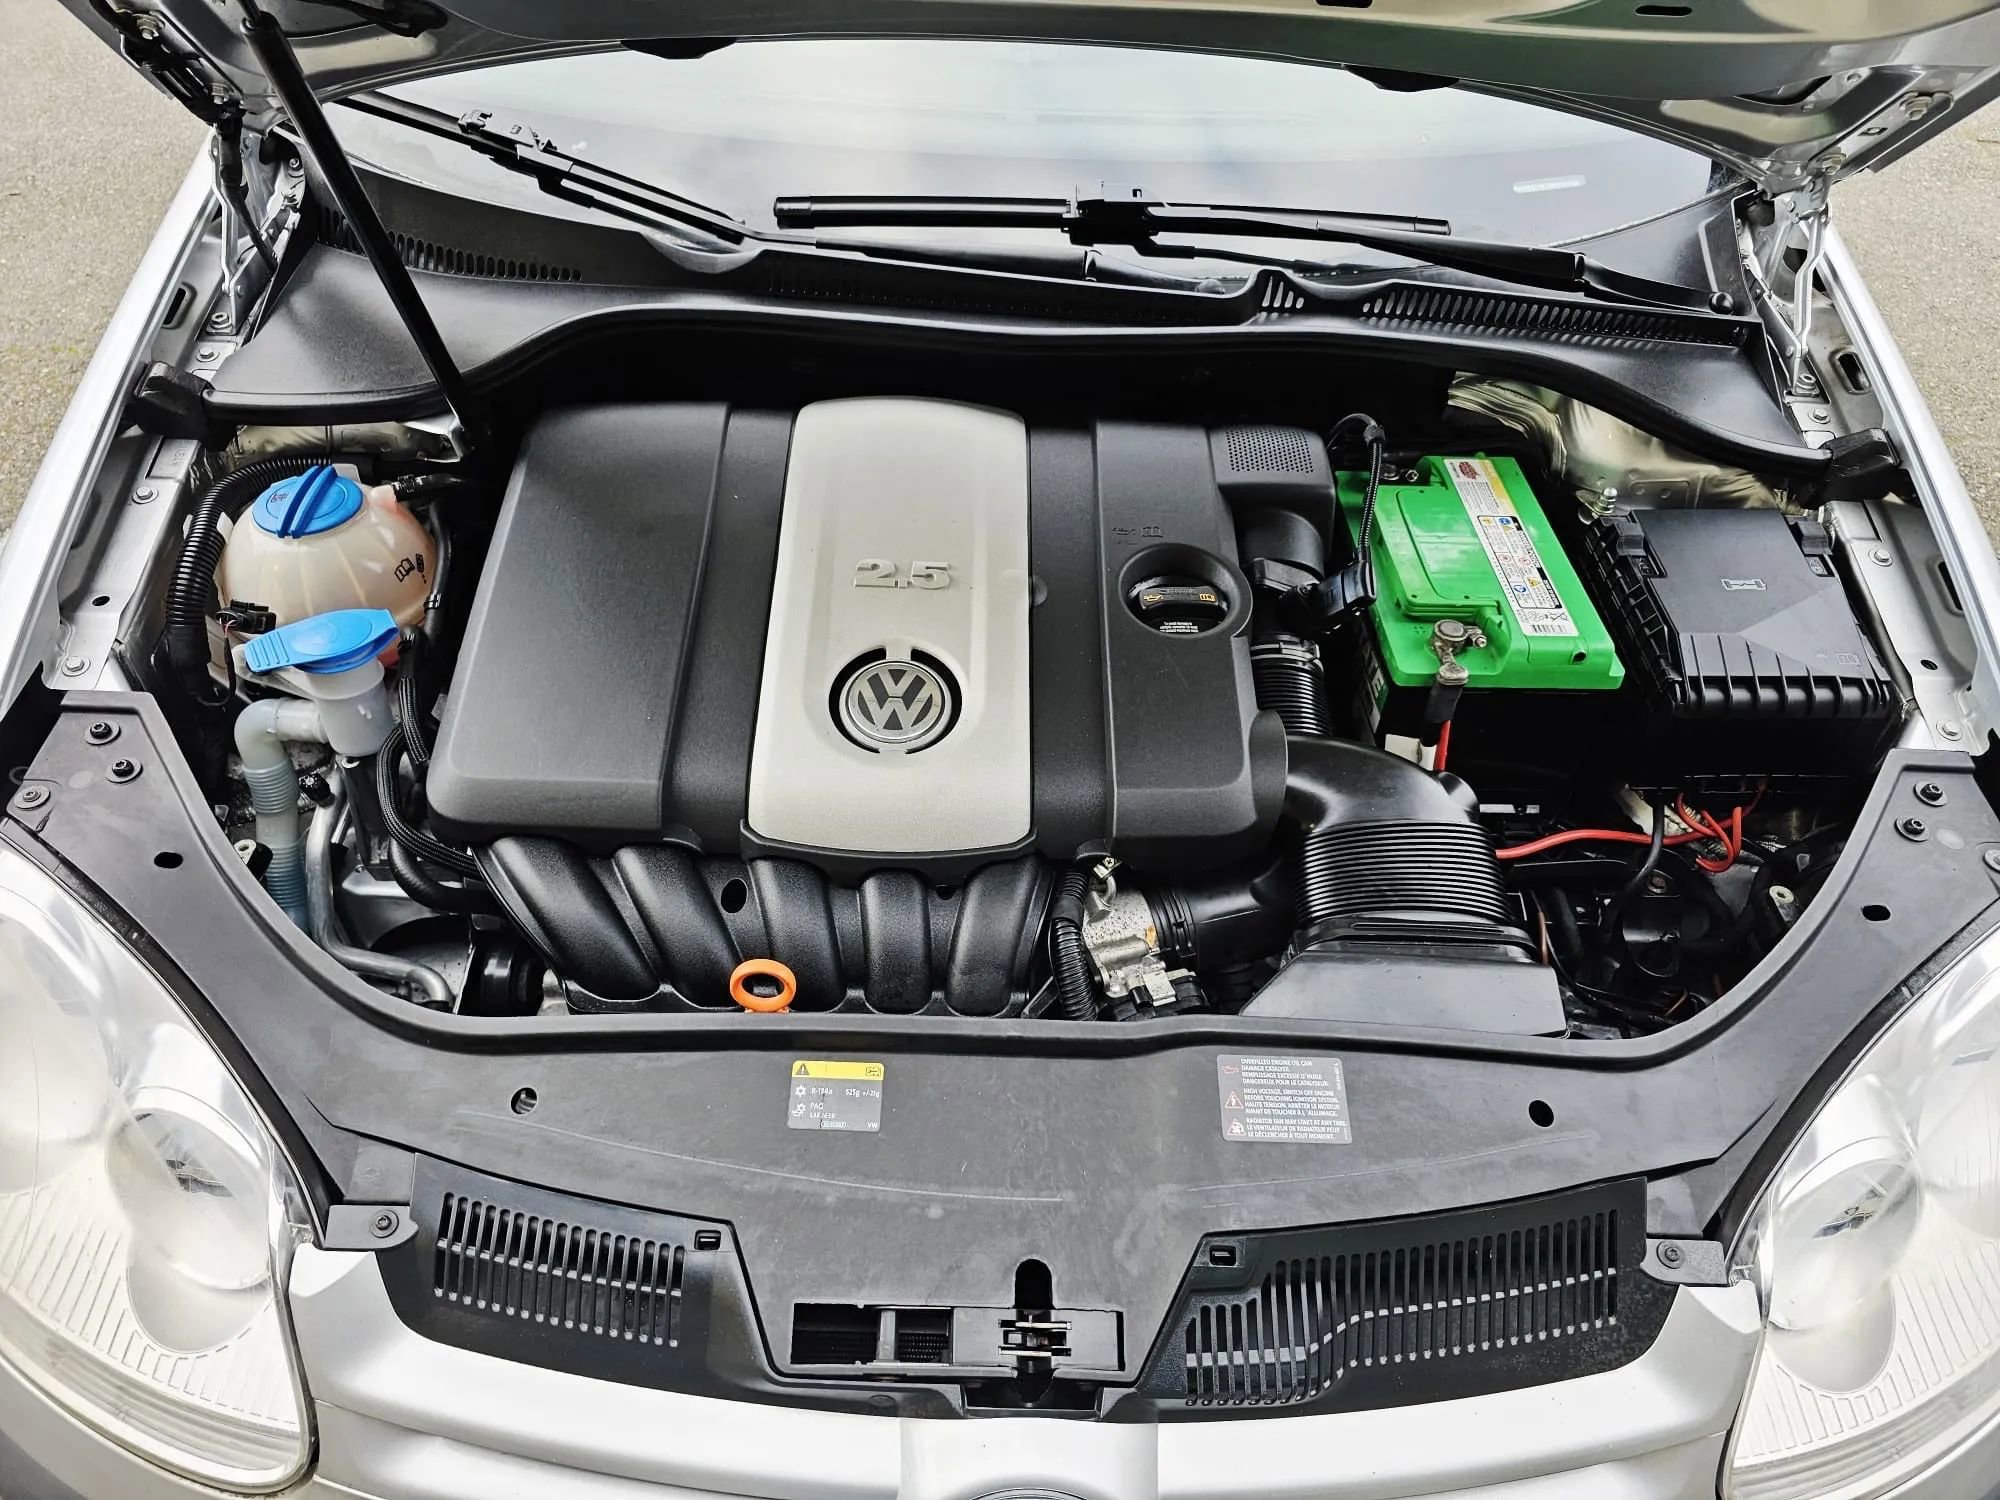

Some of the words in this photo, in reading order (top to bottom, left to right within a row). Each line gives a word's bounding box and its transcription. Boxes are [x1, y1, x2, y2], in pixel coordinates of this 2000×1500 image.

[853, 558, 951, 590] 2.5
[856, 668, 935, 732] VW
[867, 1121, 879, 1129] VW
